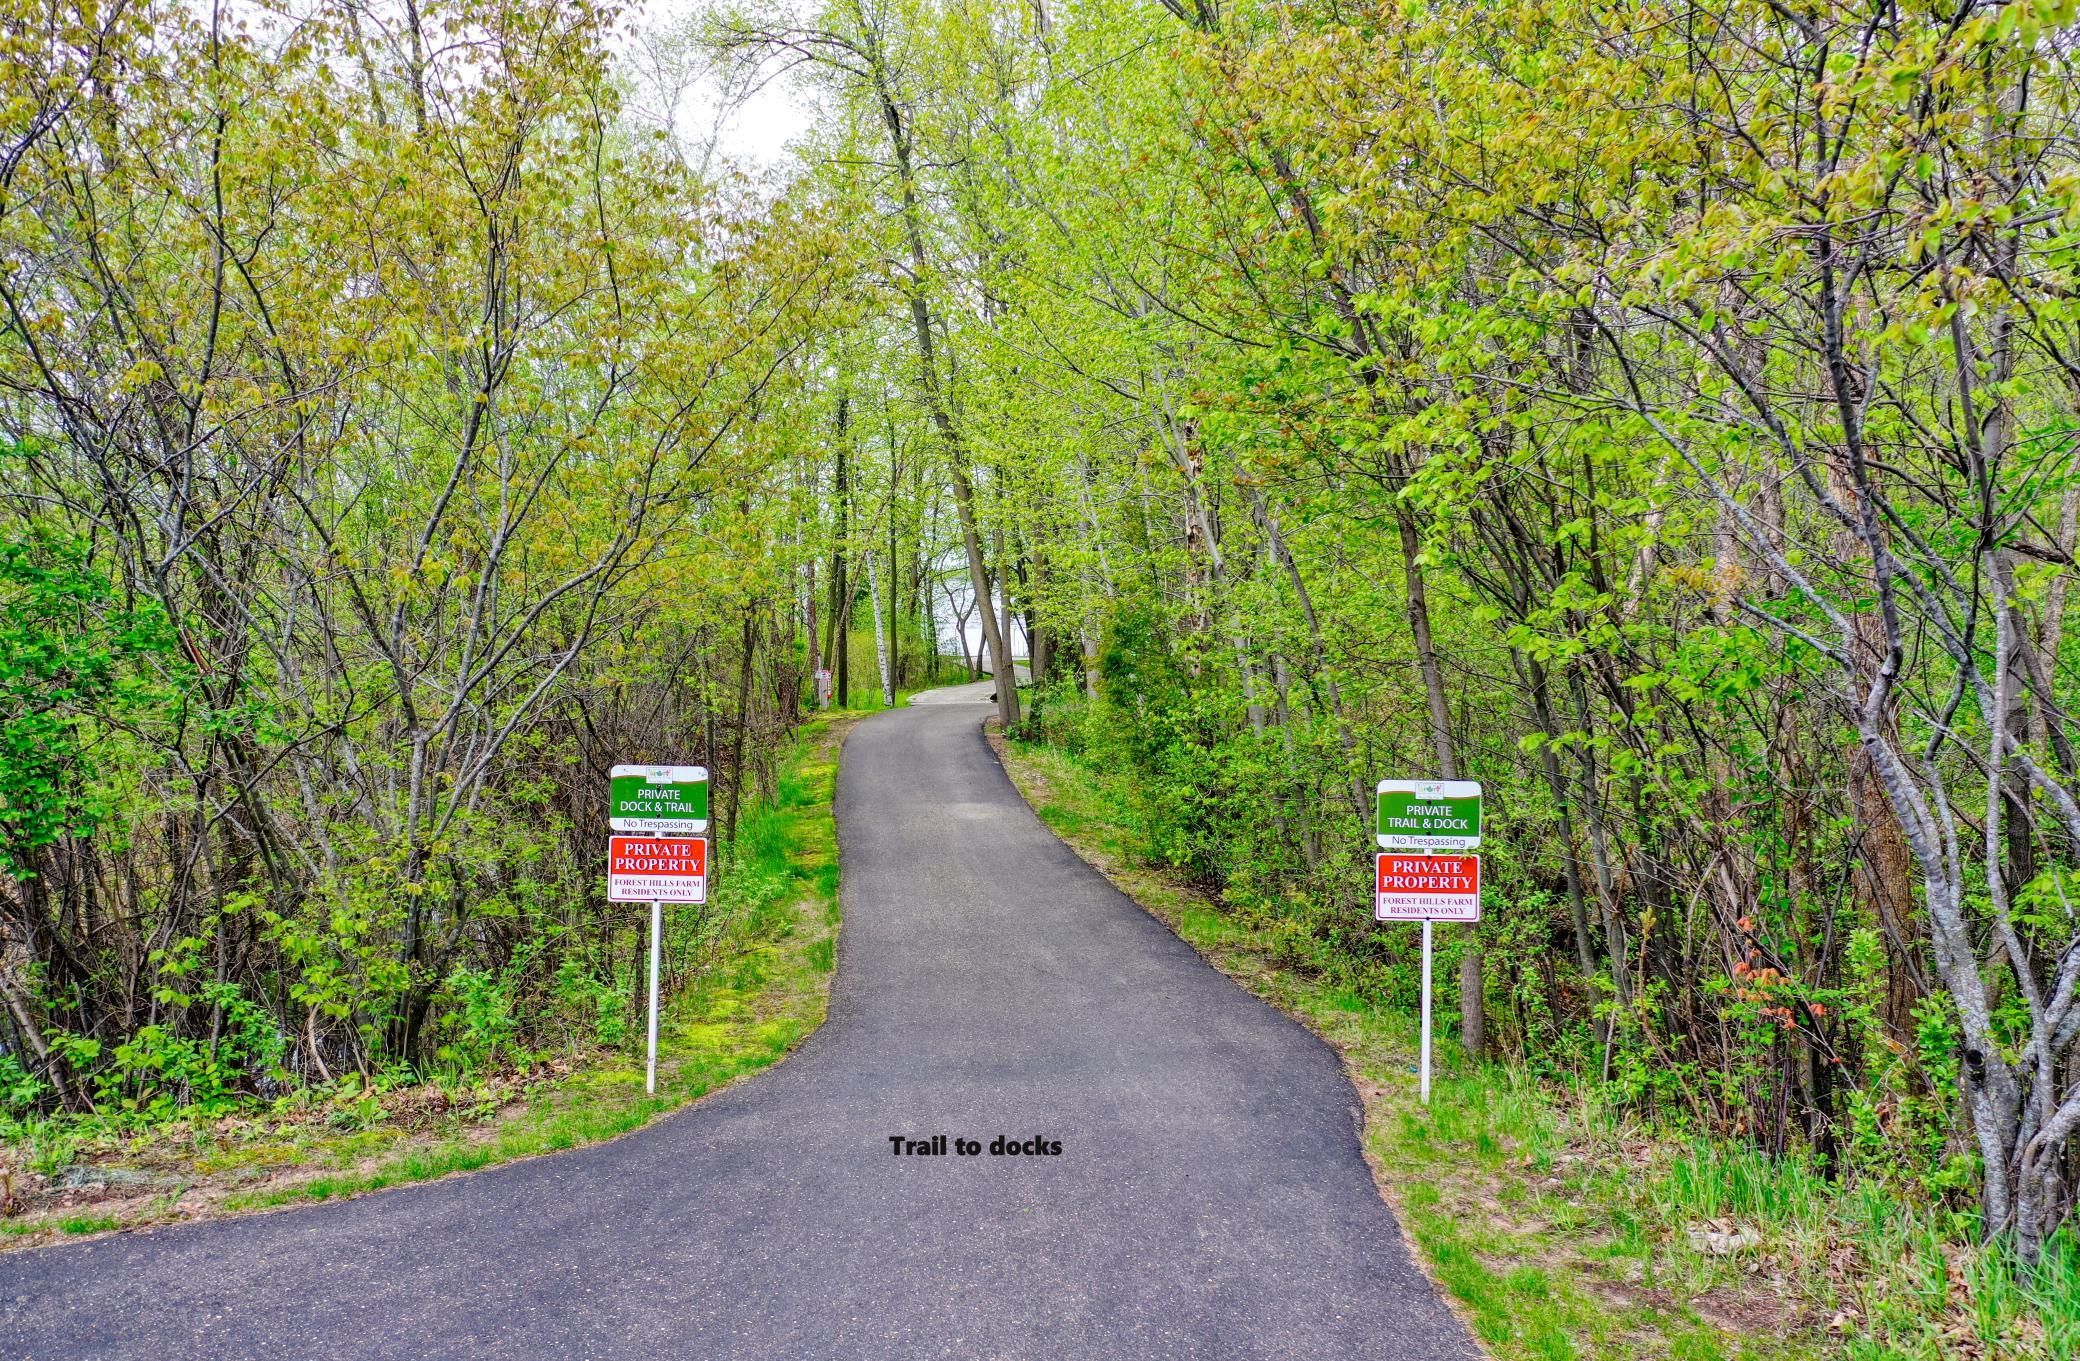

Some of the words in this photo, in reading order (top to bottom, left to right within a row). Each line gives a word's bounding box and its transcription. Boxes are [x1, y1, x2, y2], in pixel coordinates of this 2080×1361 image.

[638, 790, 680, 800] PRIVATE
[620, 801, 652, 812] DOCK
[654, 802, 662, 812] &
[665, 802, 695, 812] TRAIL
[1406, 806, 1452, 816] PRIVATE
[639, 820, 693, 830] Trespassing
[1387, 818, 1419, 828] TRAIL
[1423, 818, 1432, 828] &
[1433, 819, 1468, 829] DOCK
[1392, 836, 1406, 844] No
[1408, 837, 1466, 847] Trespassing
[625, 843, 691, 856] PRIVATE
[615, 858, 701, 871] PROPERTY
[1392, 861, 1463, 874] PRIVATE
[1383, 875, 1473, 889] PROPERTY
[622, 888, 668, 896] RESIDENTS
[1383, 897, 1418, 905] FOREST
[1390, 906, 1439, 914] RESIDENTS
